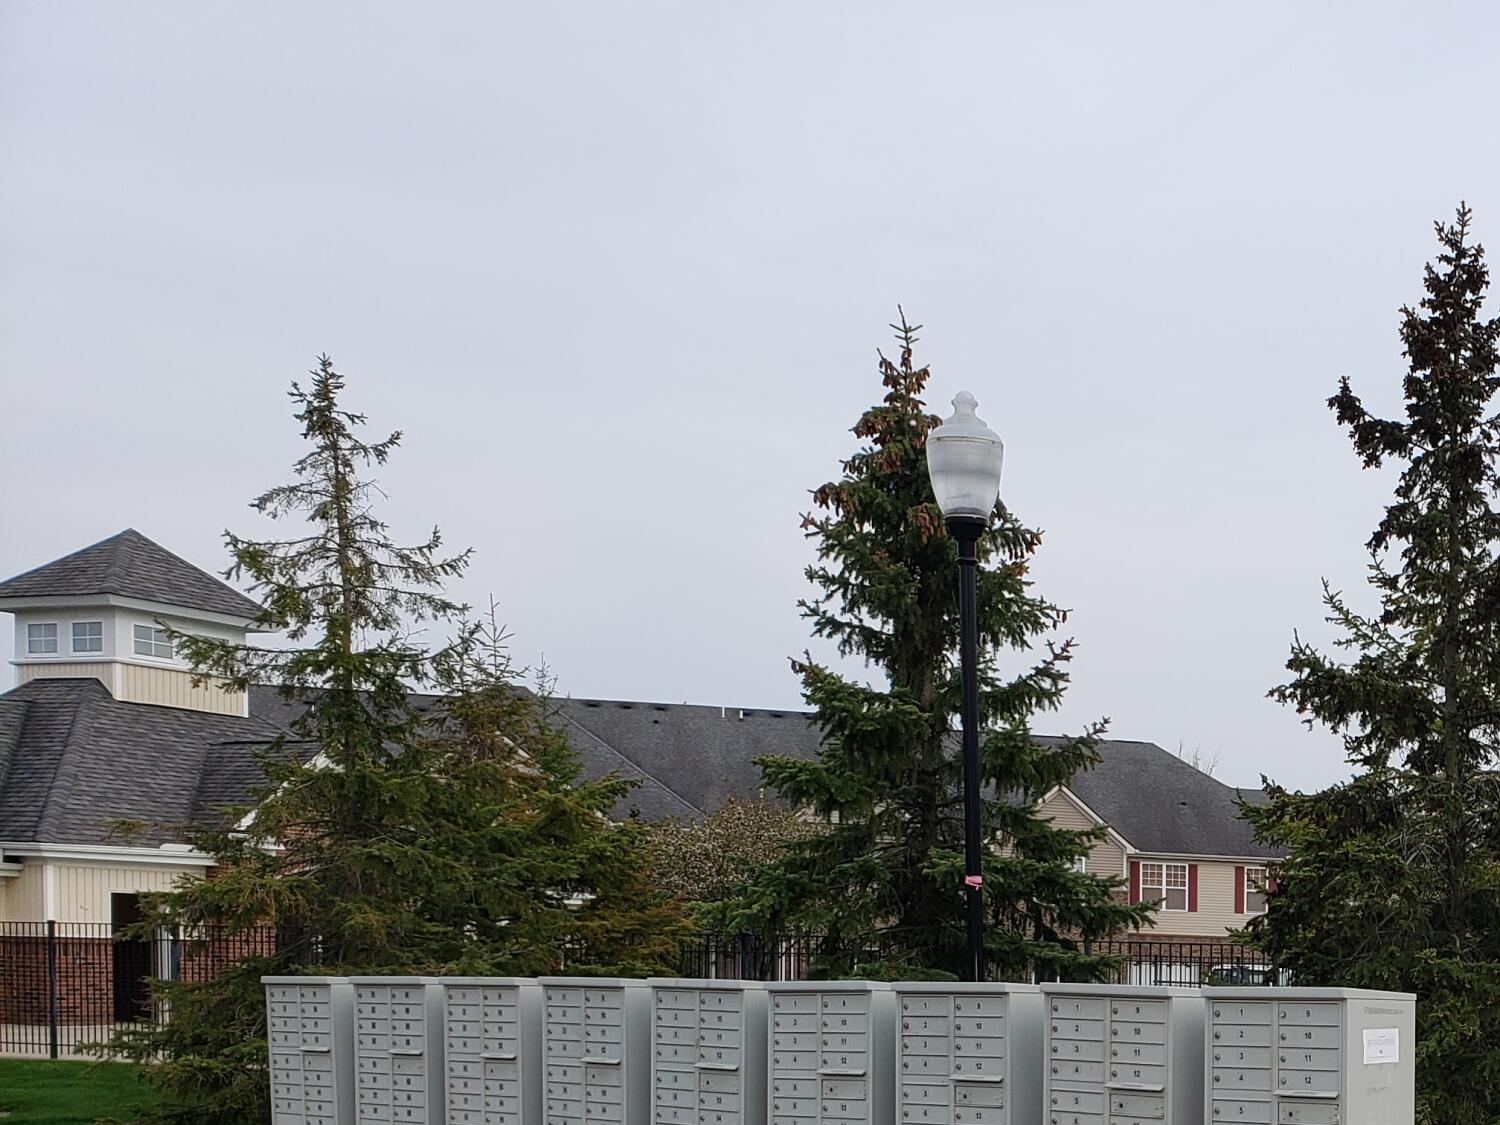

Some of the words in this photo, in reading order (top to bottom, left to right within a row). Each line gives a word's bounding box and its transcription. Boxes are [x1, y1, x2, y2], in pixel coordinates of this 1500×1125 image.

[1239, 1008, 1244, 1016] 1
[1305, 1009, 1311, 1018] 9
[1074, 1024, 1080, 1033] 2
[1133, 1027, 1142, 1036] 10
[1239, 1030, 1244, 1039] 2
[1304, 1031, 1312, 1040] 10
[1074, 1045, 1079, 1053] 3
[1133, 1048, 1141, 1057] 11
[1239, 1052, 1244, 1060] 3
[1304, 1054, 1312, 1062] 11
[1133, 1070, 1141, 1078] 12
[1304, 1076, 1312, 1085] 12
[1074, 1096, 1079, 1105] 5
[1239, 1106, 1244, 1115] 5
